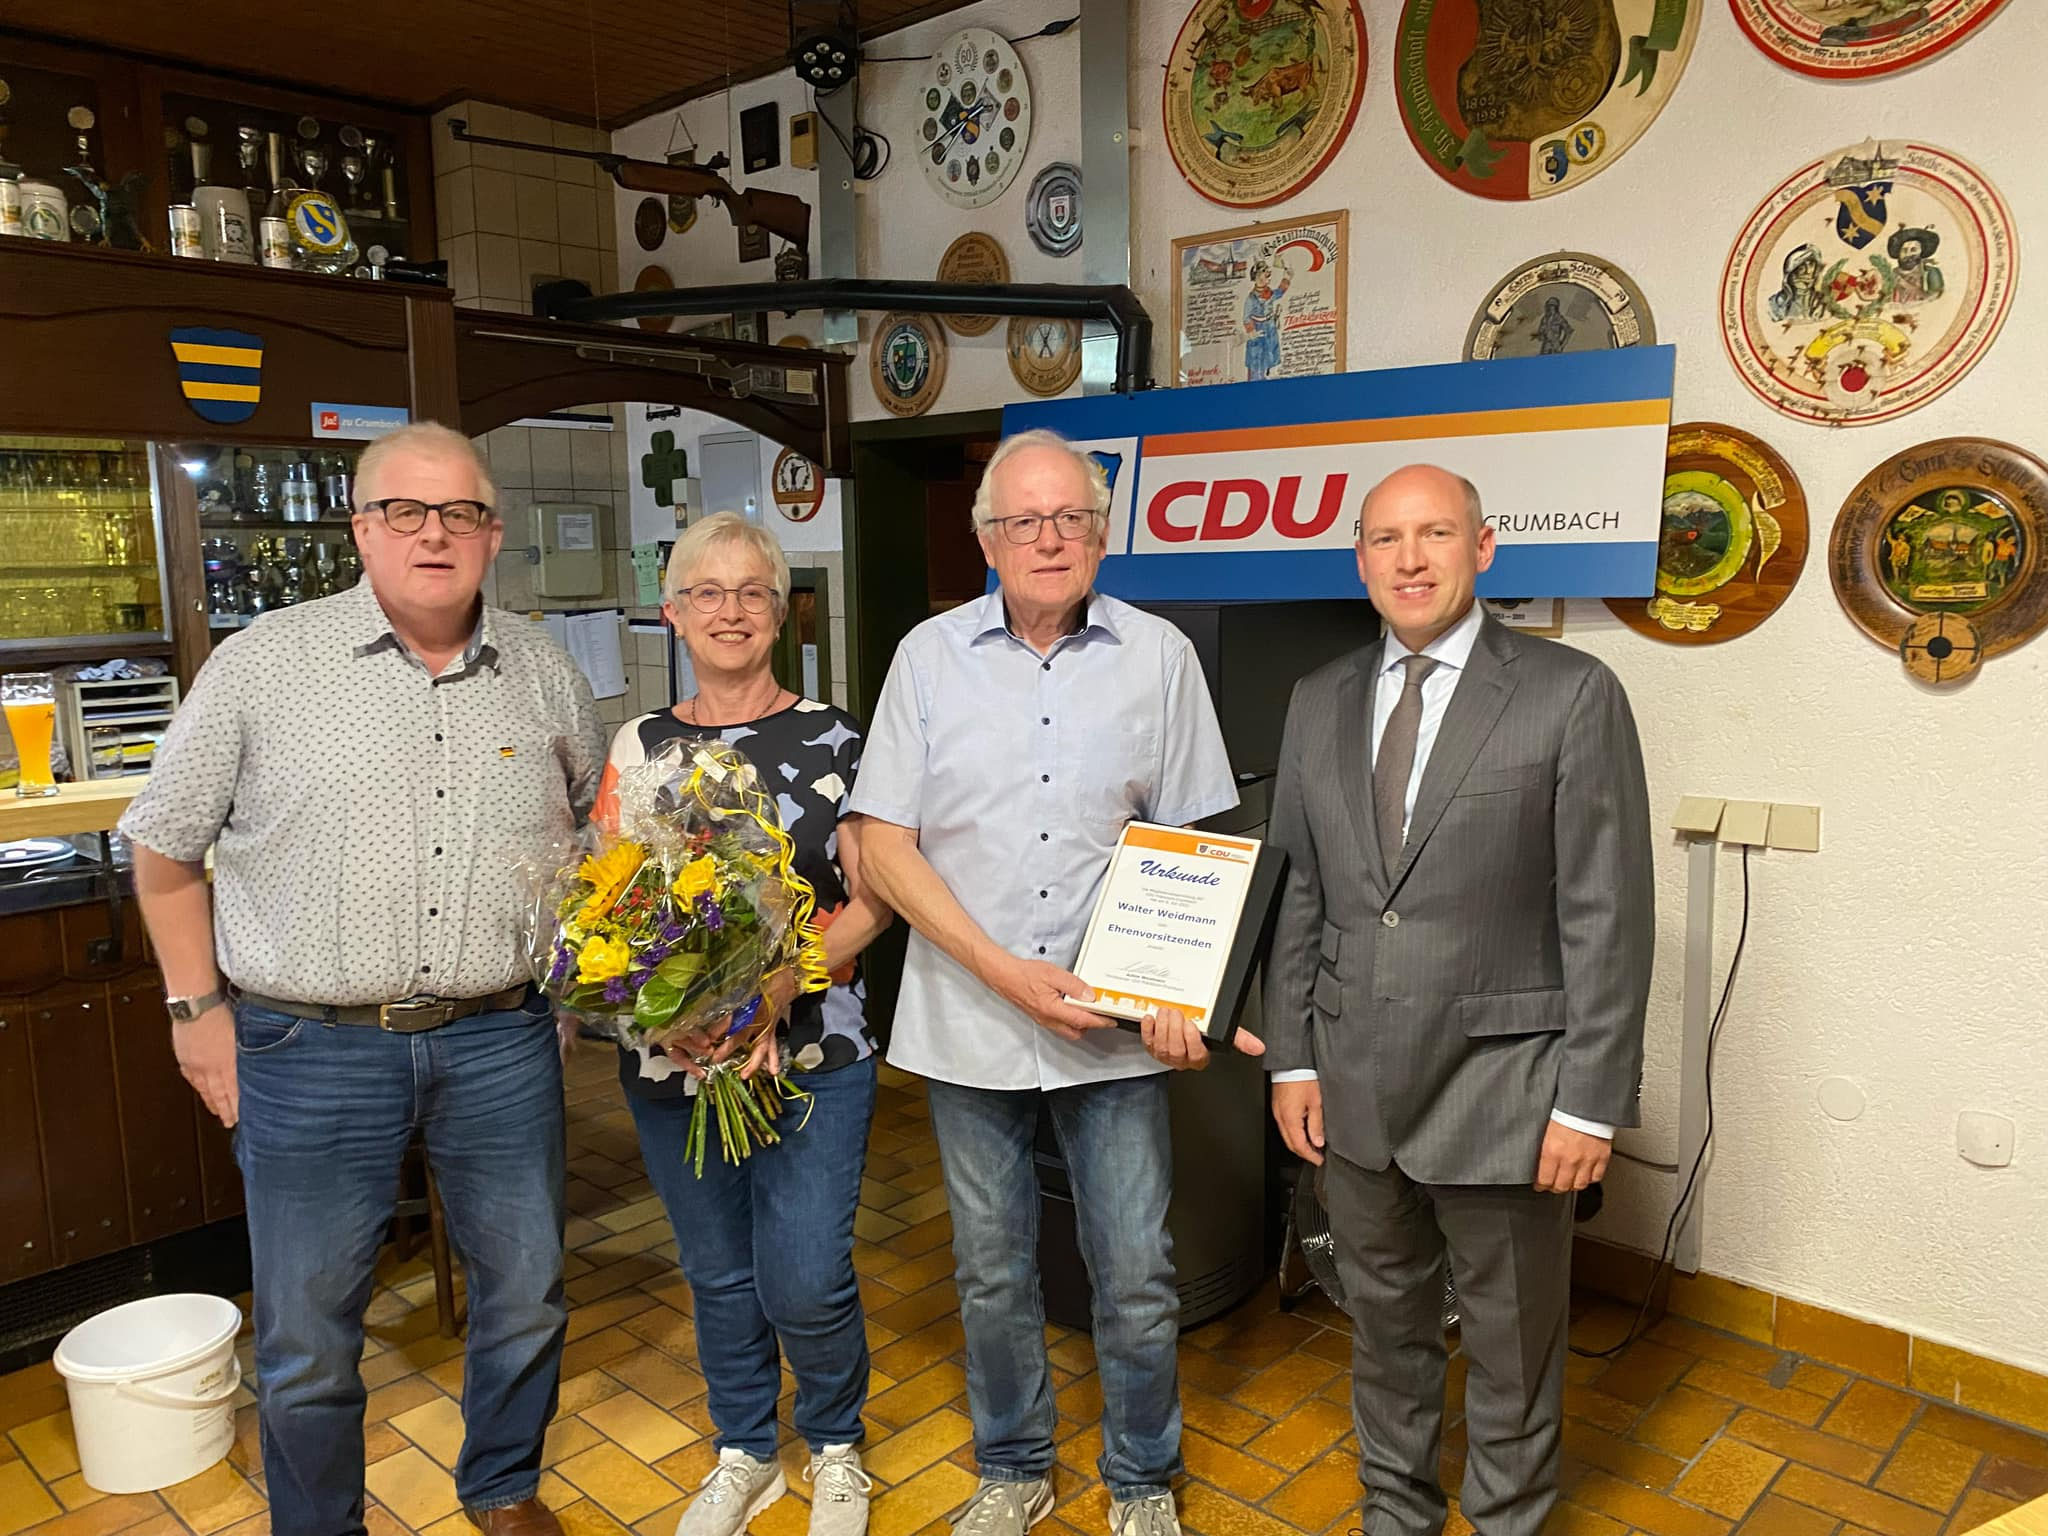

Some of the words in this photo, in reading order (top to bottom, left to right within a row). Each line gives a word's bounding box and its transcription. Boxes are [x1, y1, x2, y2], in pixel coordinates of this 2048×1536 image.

[960, 48, 972, 64] 60
[1147, 473, 1349, 542] CDU
[1209, 849, 1231, 857] CDU
[1140, 860, 1221, 886] Urkunde
[1118, 901, 1154, 916] Walter
[1157, 909, 1217, 926] Weidmann
[1107, 923, 1212, 950] Ehrenvorsitzenden
